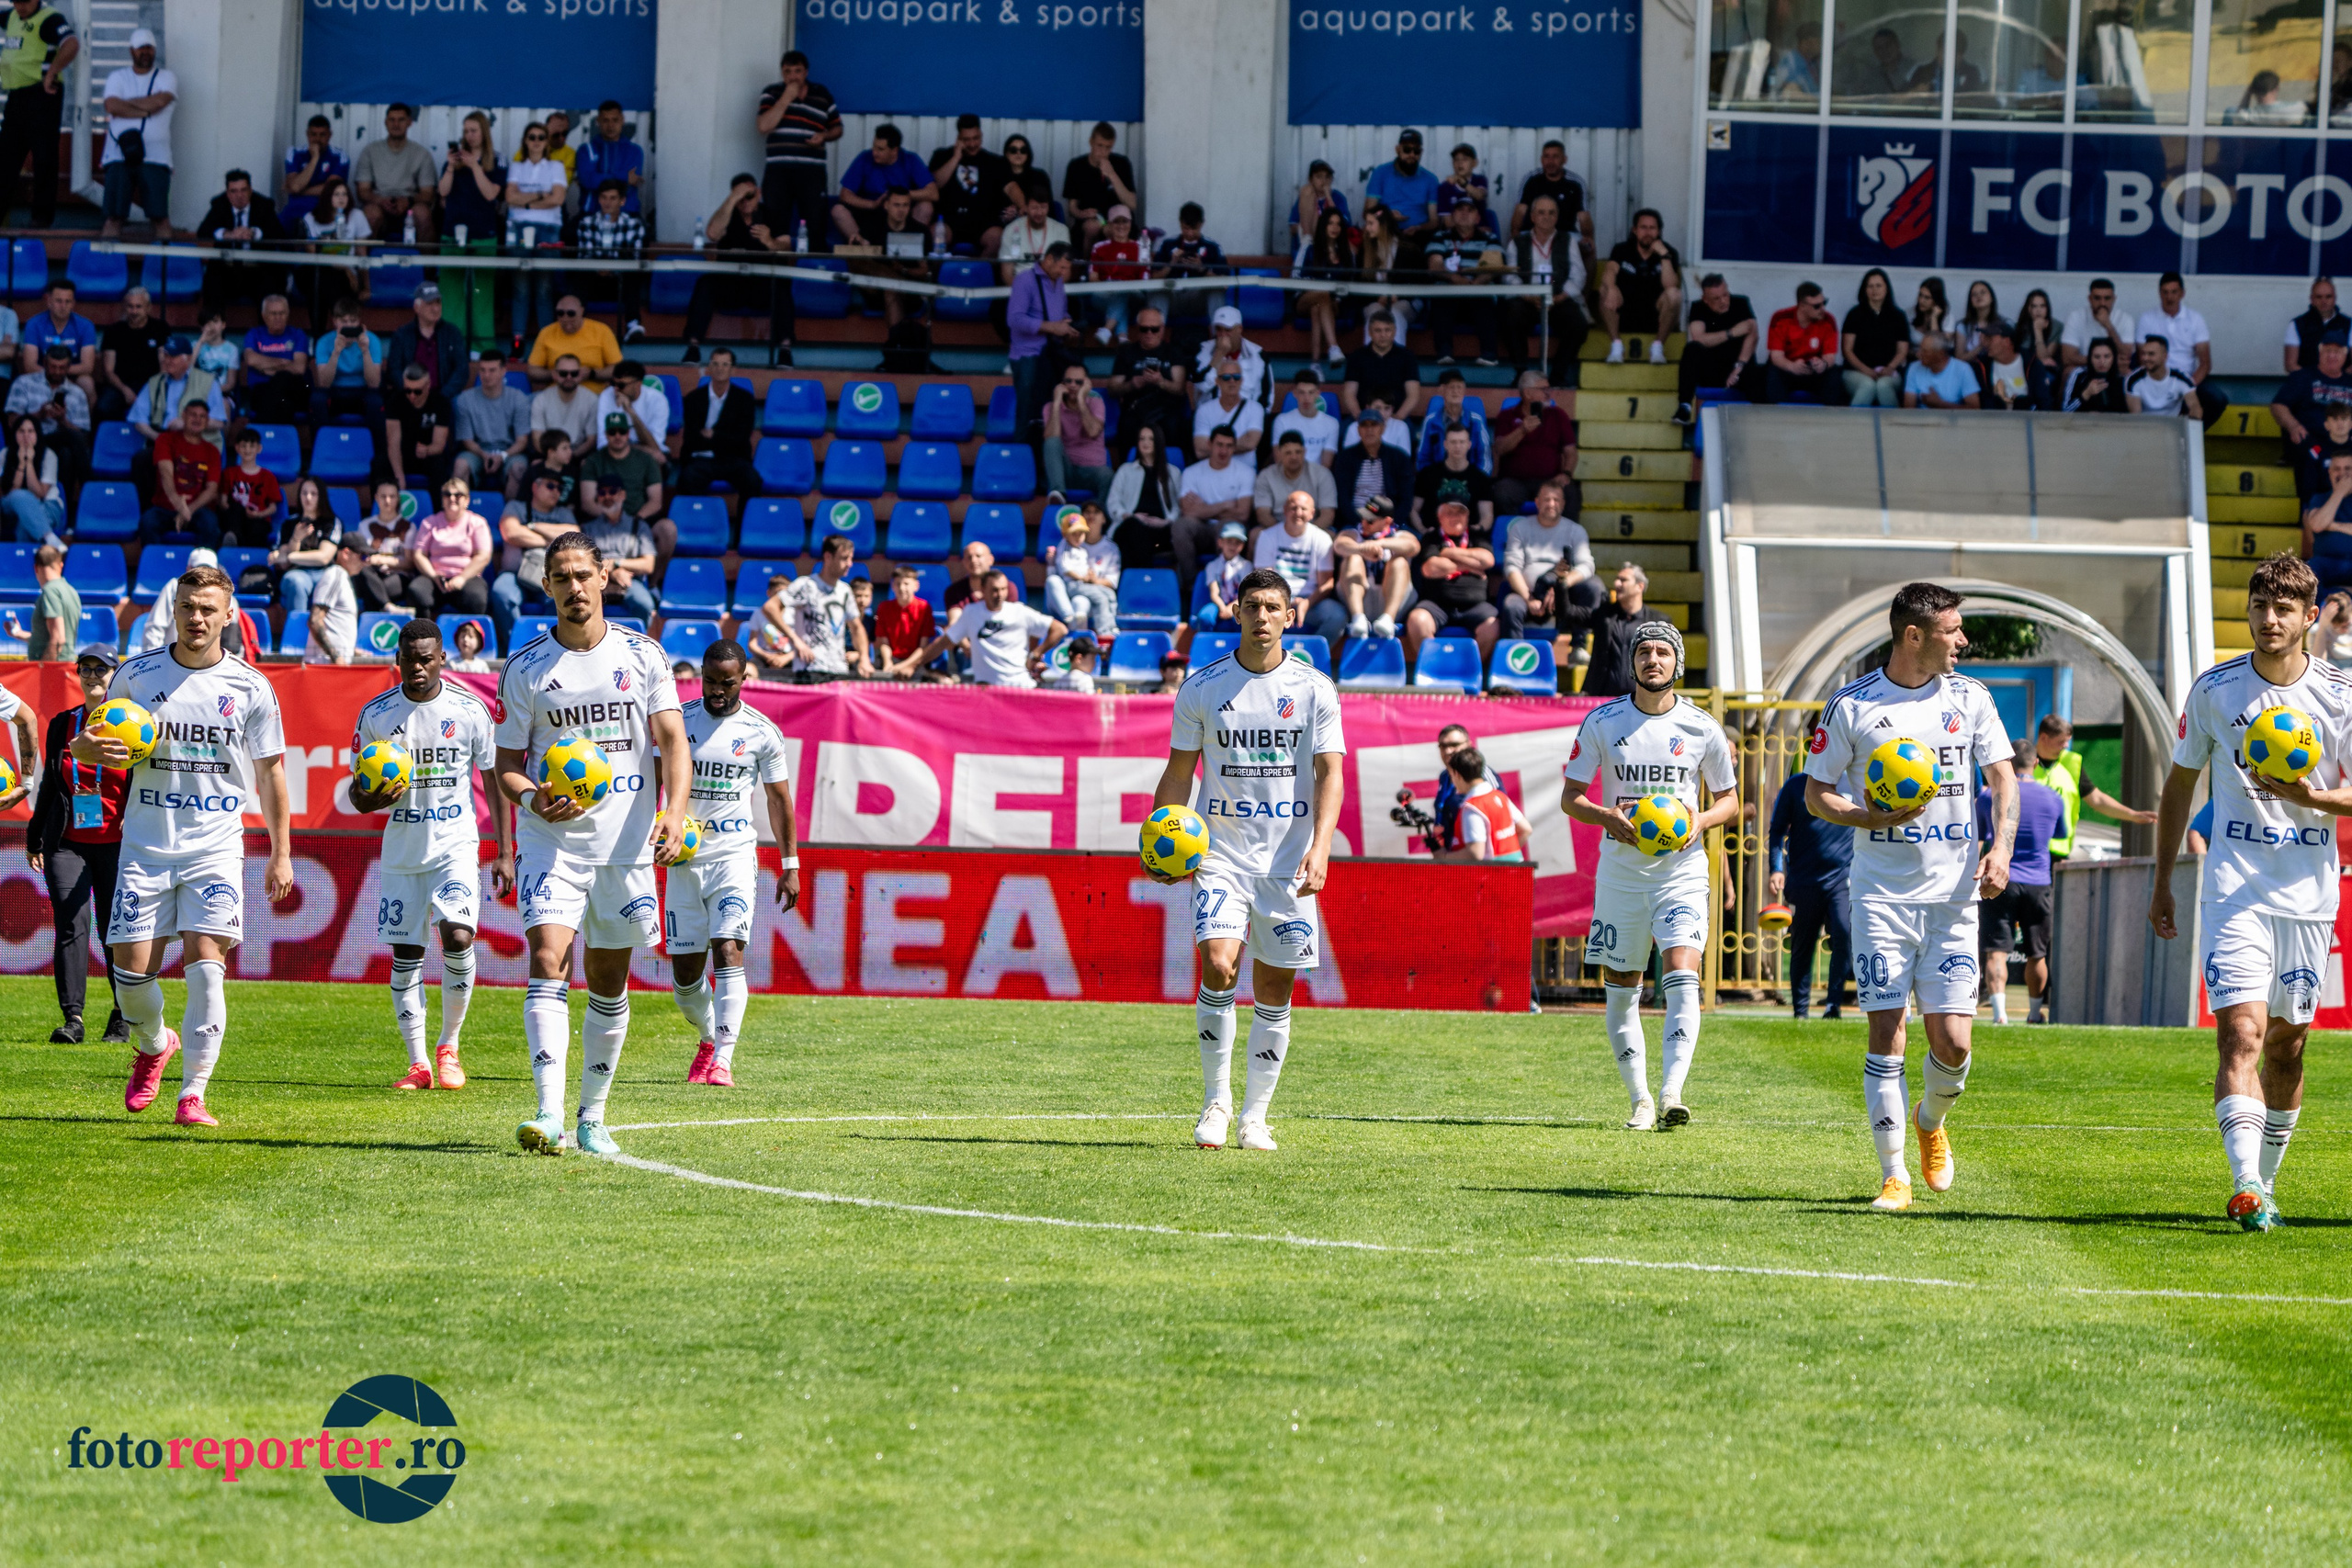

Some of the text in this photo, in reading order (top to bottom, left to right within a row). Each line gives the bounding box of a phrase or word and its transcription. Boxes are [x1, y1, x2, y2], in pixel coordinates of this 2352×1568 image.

[544, 0, 650, 20] sports
[805, 0, 1142, 30] aquapark & sports
[1299, 6, 1636, 38] aquapark & sports
[1971, 166, 2352, 242] FC BOTO
[1627, 397, 1639, 419] 7
[2238, 412, 2249, 434] 7
[1619, 455, 1634, 477] 6
[1620, 513, 1634, 536] 5
[2243, 533, 2256, 555] 5
[520, 652, 551, 674] ELECTROALFA
[128, 664, 162, 681] ELECTROALFA
[1194, 668, 1228, 688] ELECTROALFA
[2203, 676, 2239, 694] ELECTROALFA
[547, 701, 635, 728] UNIBET
[156, 721, 237, 747] UNIBET
[1217, 729, 1303, 749] UNIBET
[2299, 731, 2312, 746] 12
[598, 739, 628, 751] SPRE 0%
[130, 747, 143, 761] 12
[405, 748, 460, 764] NIBET
[193, 761, 213, 773] SPRE
[212, 763, 225, 773] 0%
[692, 760, 748, 780] NIBET
[1225, 764, 1294, 777] ÎMPREUNĂ SPRE 0%
[1614, 764, 1690, 784] UNIBET
[426, 778, 443, 787] SPRE
[442, 778, 454, 787] 0%
[573, 783, 590, 797] 12
[1876, 783, 1892, 798] 12
[1935, 785, 1963, 795] PRE 0%
[139, 788, 239, 812] ELSACO
[1207, 798, 1309, 818] ELSACO
[694, 818, 749, 833] SACO
[1168, 819, 1182, 832] 12
[2226, 820, 2330, 846] ELSACO
[1657, 833, 1672, 846] 12
[521, 872, 552, 906] 44
[112, 888, 140, 922] 33
[378, 897, 404, 926] 83
[537, 908, 563, 916] Vestra
[622, 903, 635, 916] FIVE
[1196, 888, 1228, 920] 27
[126, 924, 152, 933] Vestra
[388, 929, 409, 937] Vestra
[1275, 926, 1285, 934] FIVE
[1591, 919, 1617, 951] 20
[1607, 953, 1626, 964] Vestra
[1941, 960, 1952, 973] FIVE
[1857, 953, 1889, 988] 30
[2205, 951, 2220, 987] 6
[2282, 973, 2295, 983] FIVE
[1875, 990, 1901, 1000] Vestra
[2213, 986, 2242, 997] Vestra
[195, 1030, 222, 1038] adidas
[533, 1058, 557, 1068] adidas
[1618, 1052, 1640, 1062] adidas
[588, 1066, 613, 1077] adidas
